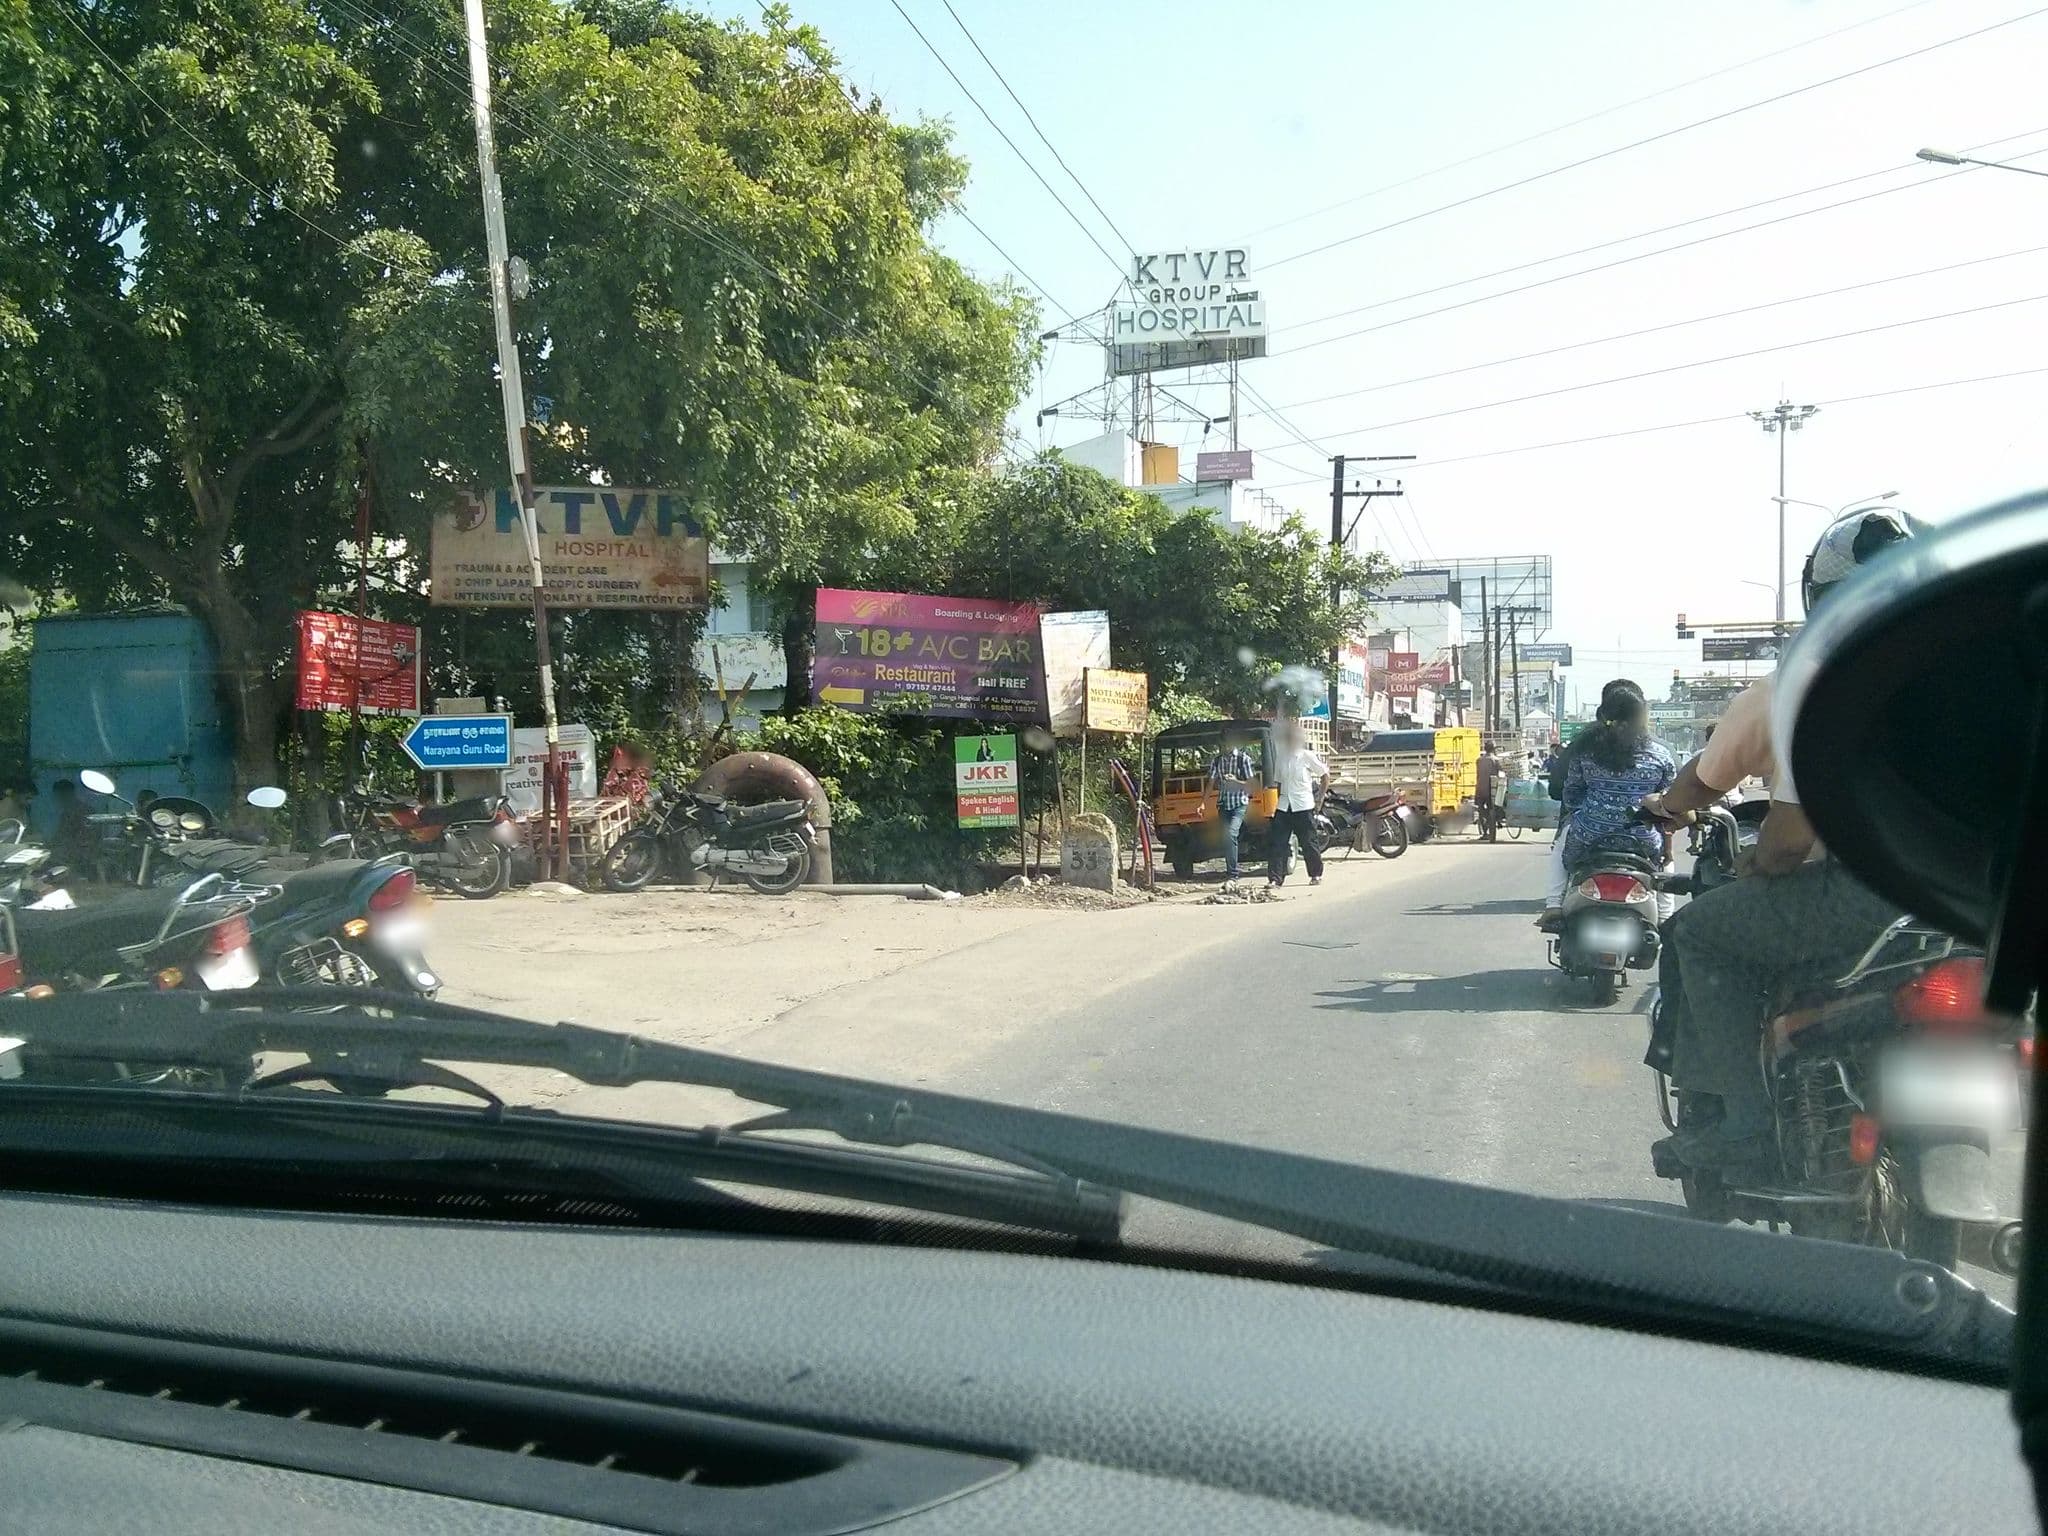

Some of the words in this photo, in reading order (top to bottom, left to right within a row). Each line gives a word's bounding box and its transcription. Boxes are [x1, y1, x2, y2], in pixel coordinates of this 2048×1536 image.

[1134, 249, 1247, 285] KTVR
[1150, 284, 1221, 304] GROUP
[1117, 303, 1262, 334] HOSPITAL
[494, 489, 703, 538] KTVR
[554, 541, 649, 558] HOSPITAL
[455, 564, 502, 574] TRAUMA
[505, 564, 513, 574] &
[516, 564, 574, 576] ACDENT
[577, 566, 608, 575] CARE
[465, 578, 492, 588] CHIP
[496, 578, 584, 589] LAPARSCOPIC
[587, 580, 641, 590] SURGERY
[454, 592, 516, 601] INTENSIVE
[519, 593, 581, 603] COONARY
[586, 594, 593, 602] &
[597, 594, 674, 604] RESPIRATORY
[934, 608, 974, 620] Boarding
[974, 611, 982, 620] &
[855, 628, 914, 657] 18+
[918, 634, 969, 661] A/C
[978, 637, 1033, 664] BAR
[874, 663, 957, 685] Restaurant
[1390, 673, 1417, 681] GOLD
[1390, 684, 1416, 692] LOAN
[1114, 690, 1145, 702] MAHAL
[461, 727, 479, 739] குரு
[423, 745, 461, 757] Narayana
[462, 744, 482, 754] Guru
[484, 743, 505, 754] Road
[528, 753, 550, 763] cam
[963, 765, 1009, 780] JKR
[960, 795, 987, 807] Spoken
[988, 794, 1015, 805] English
[974, 806, 982, 815] &
[982, 805, 1002, 815] Hindi
